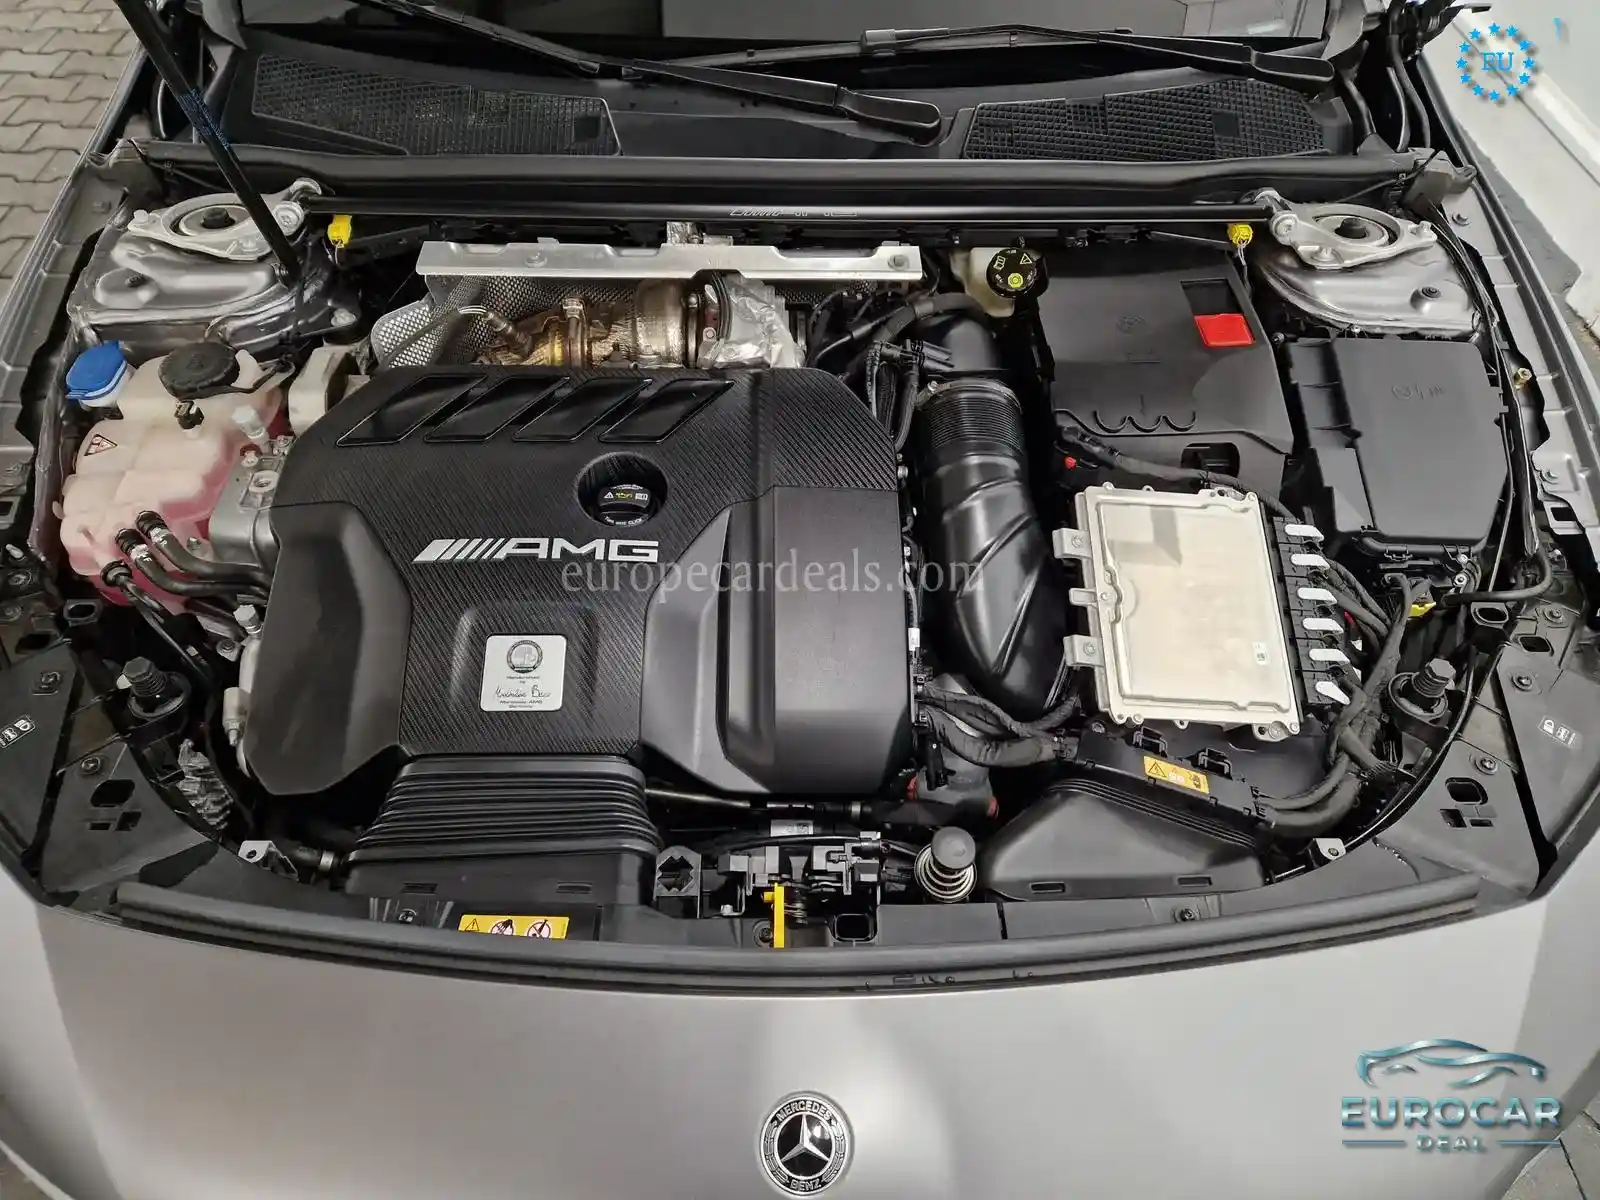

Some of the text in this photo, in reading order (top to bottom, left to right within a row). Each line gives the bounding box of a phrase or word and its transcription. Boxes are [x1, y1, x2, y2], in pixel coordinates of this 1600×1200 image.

[493, 538, 659, 562] AMG
[776, 1100, 832, 1121] MERCEDES
[790, 1178, 822, 1192] BENZ
